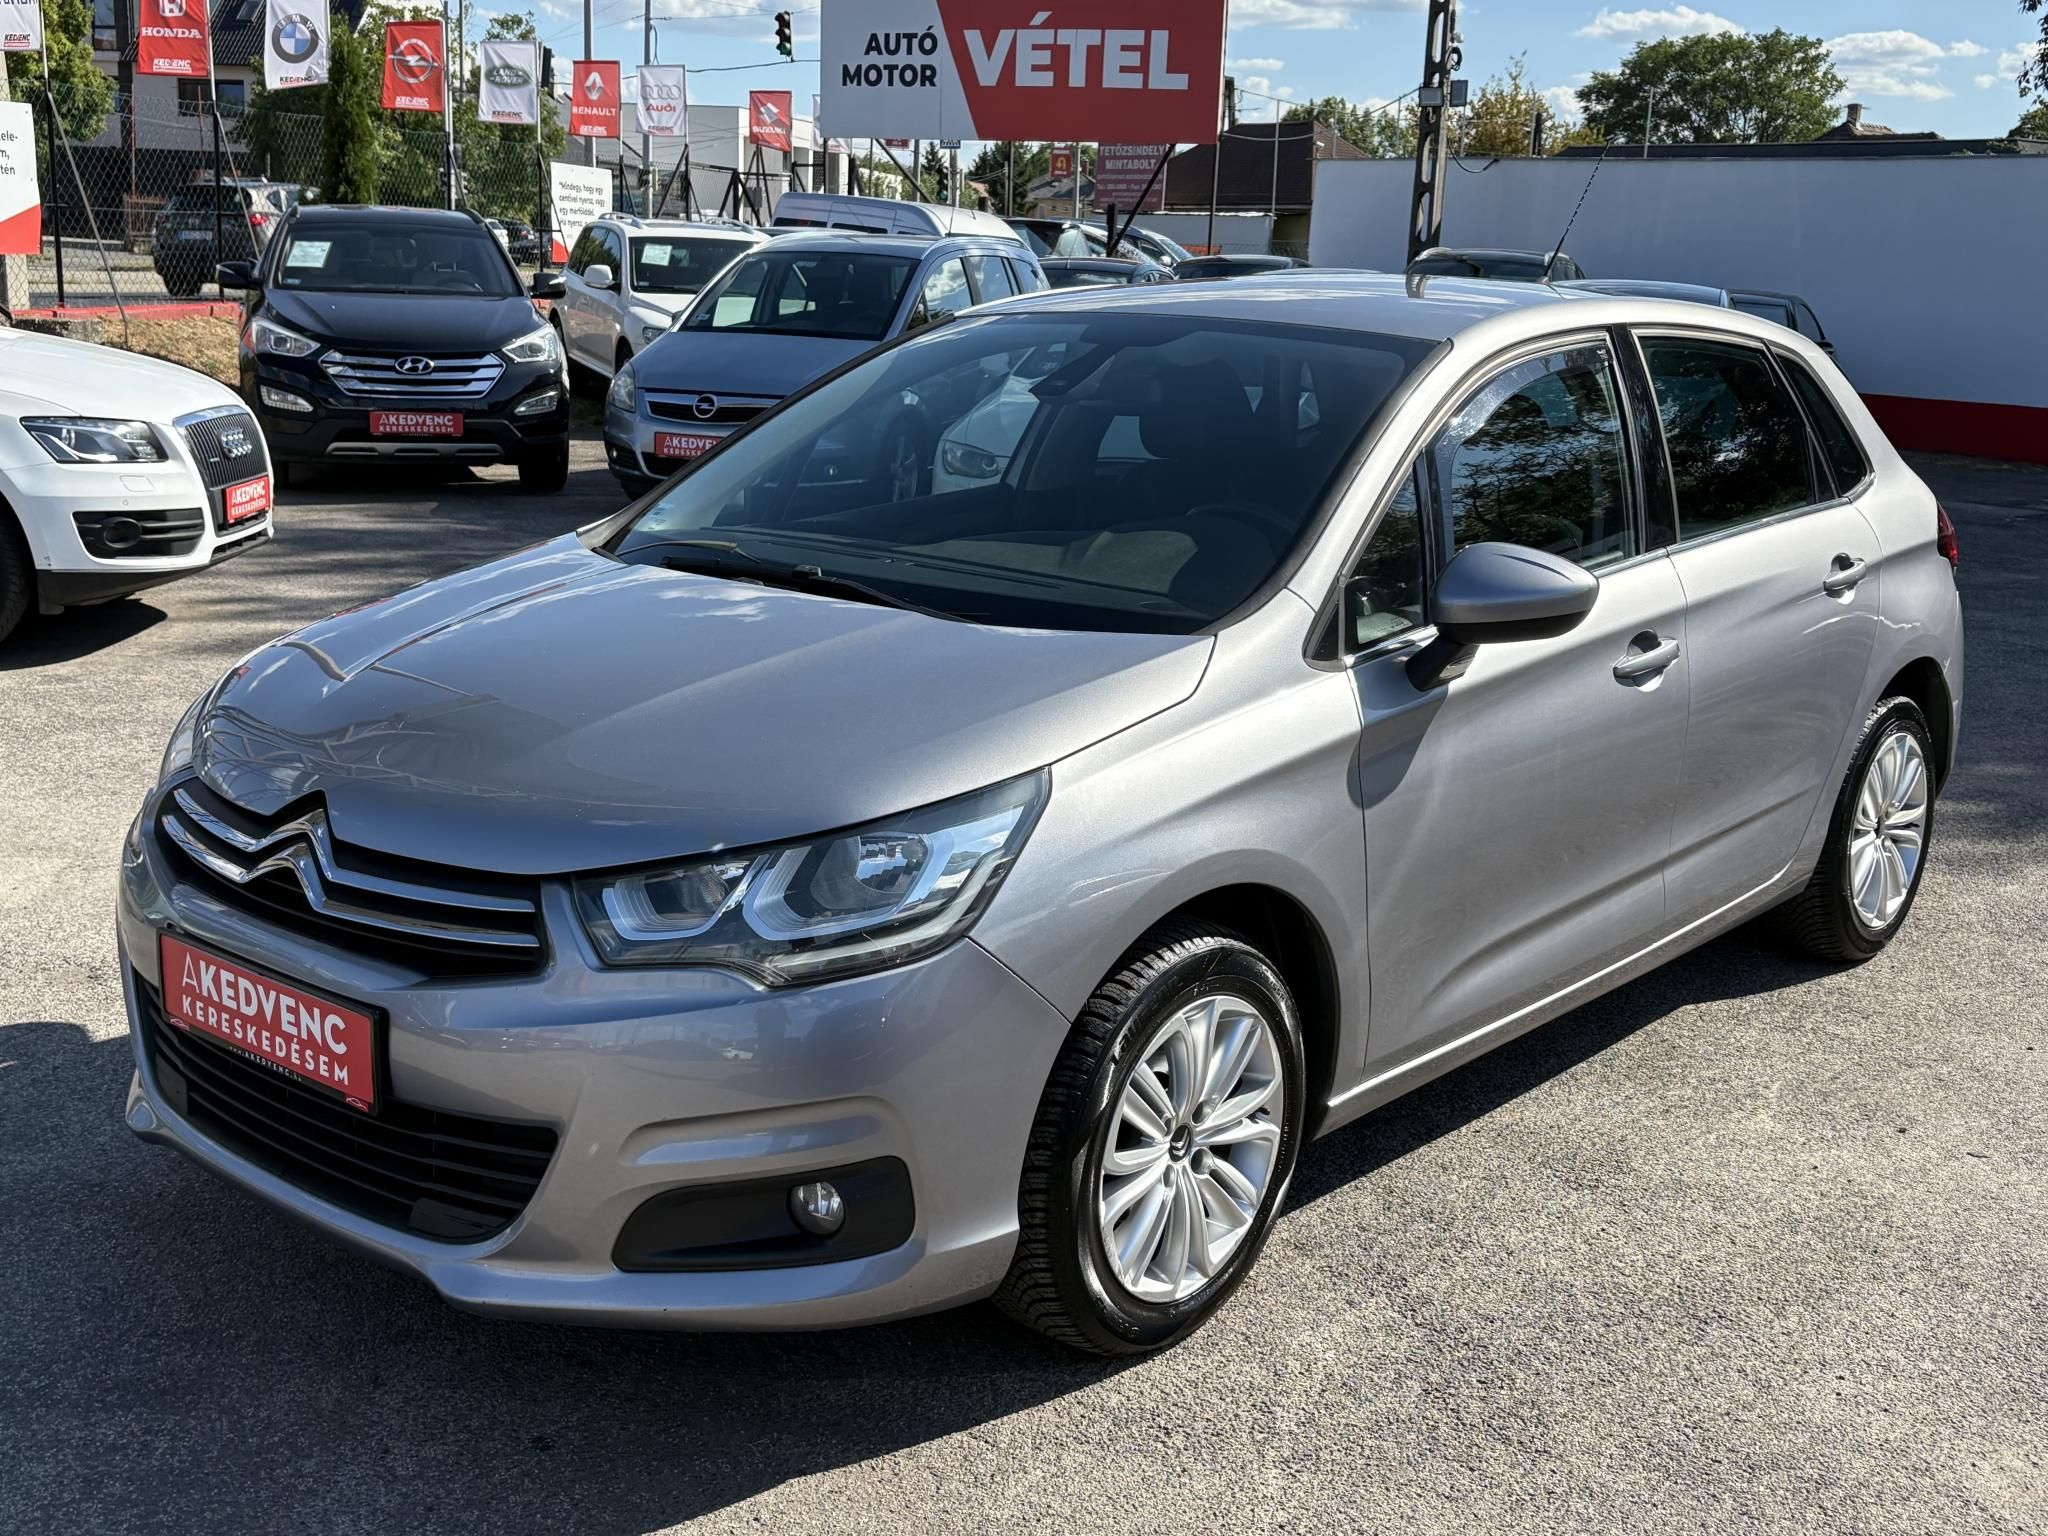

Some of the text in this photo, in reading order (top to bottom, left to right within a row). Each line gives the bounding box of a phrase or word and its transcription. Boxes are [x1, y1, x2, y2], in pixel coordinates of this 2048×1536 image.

[276, 14, 315, 32] BMW
[141, 26, 203, 39] HONDA
[864, 25, 938, 56] AUTÓ
[963, 11, 1189, 90] VÉTEL
[493, 68, 517, 76] LAND
[841, 64, 937, 87] MOTOR
[494, 76, 523, 84] ROVER
[572, 105, 617, 117] RENAULT
[1105, 159, 1156, 170] MINTABOLT
[182, 994, 350, 1086] KERESKEDÉSEM
